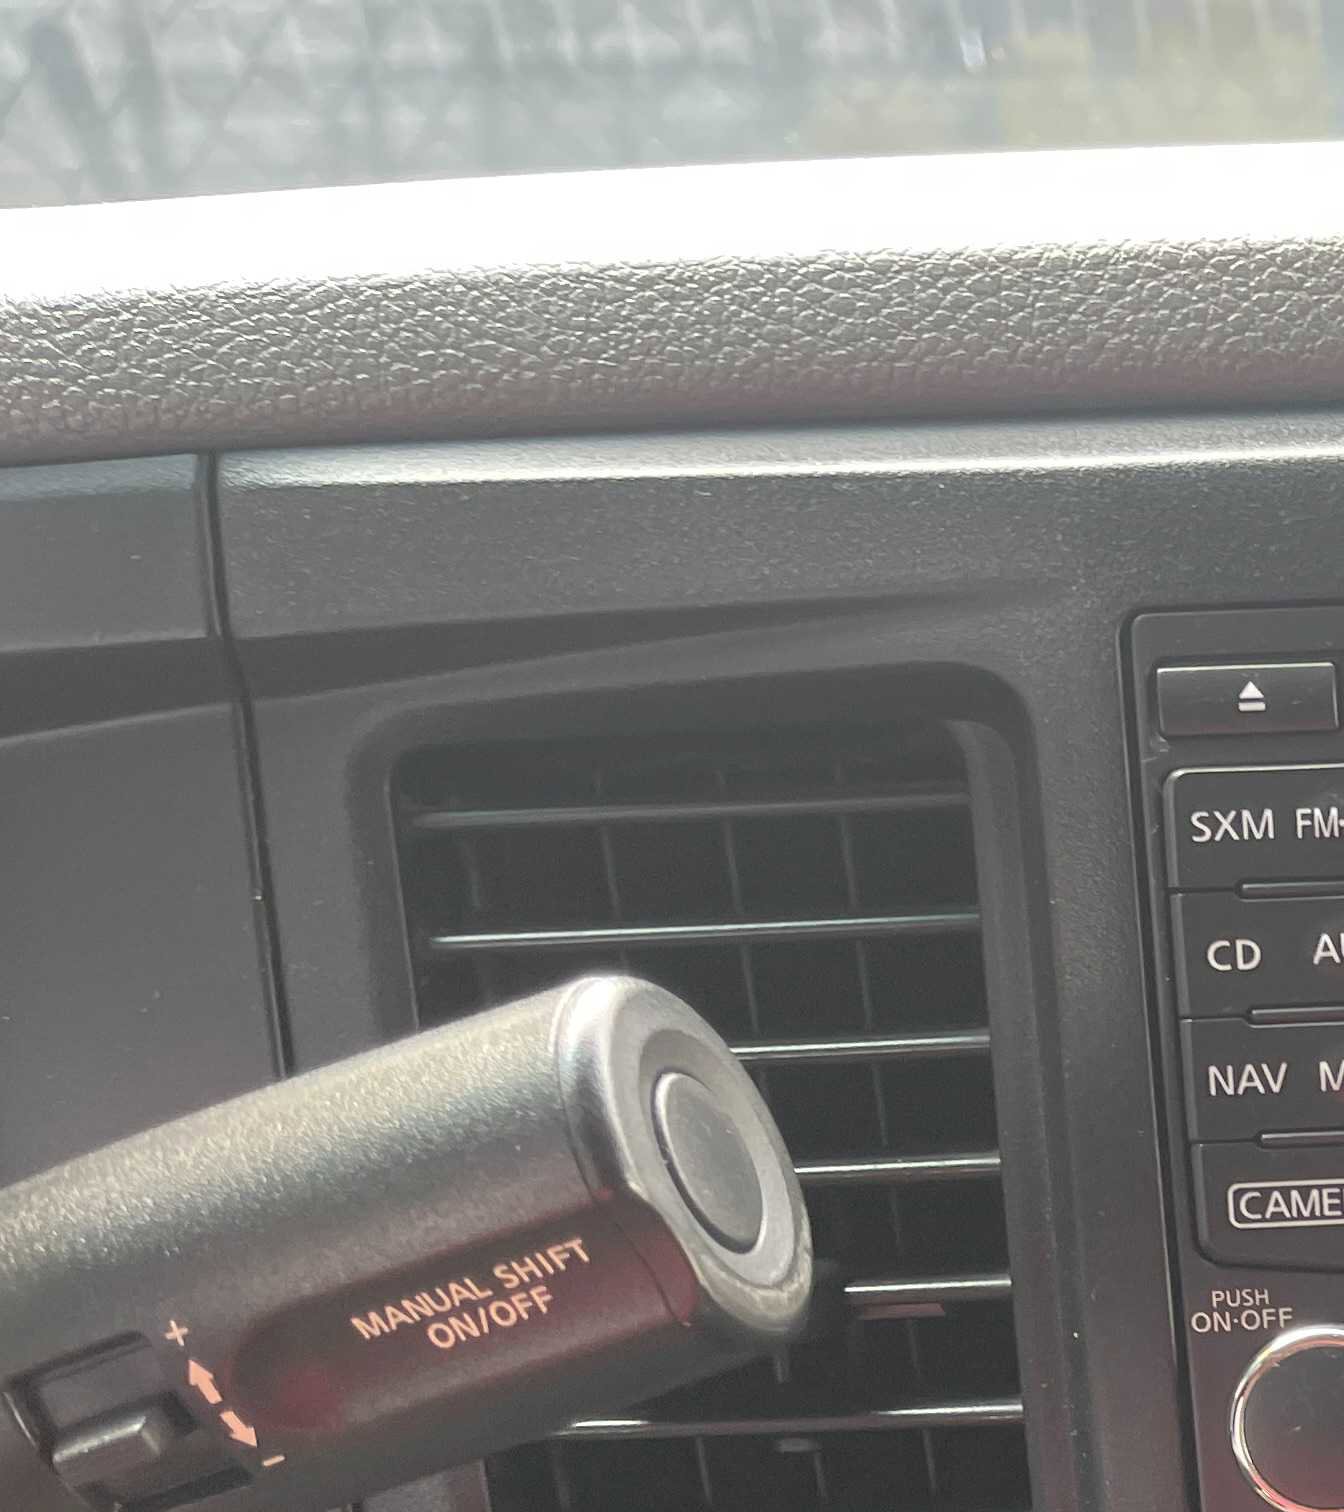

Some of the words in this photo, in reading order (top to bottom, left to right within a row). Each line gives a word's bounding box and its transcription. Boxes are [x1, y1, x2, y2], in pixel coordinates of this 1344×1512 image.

[1190, 807, 1275, 843] SXM
[1206, 937, 1262, 973] CD
[1207, 1062, 1289, 1098] NAV
[350, 1276, 494, 1340] MANUAL
[492, 1236, 591, 1290] SHIFT
[1211, 1288, 1271, 1308] PUSH
[426, 1285, 554, 1349] ON/OFF
